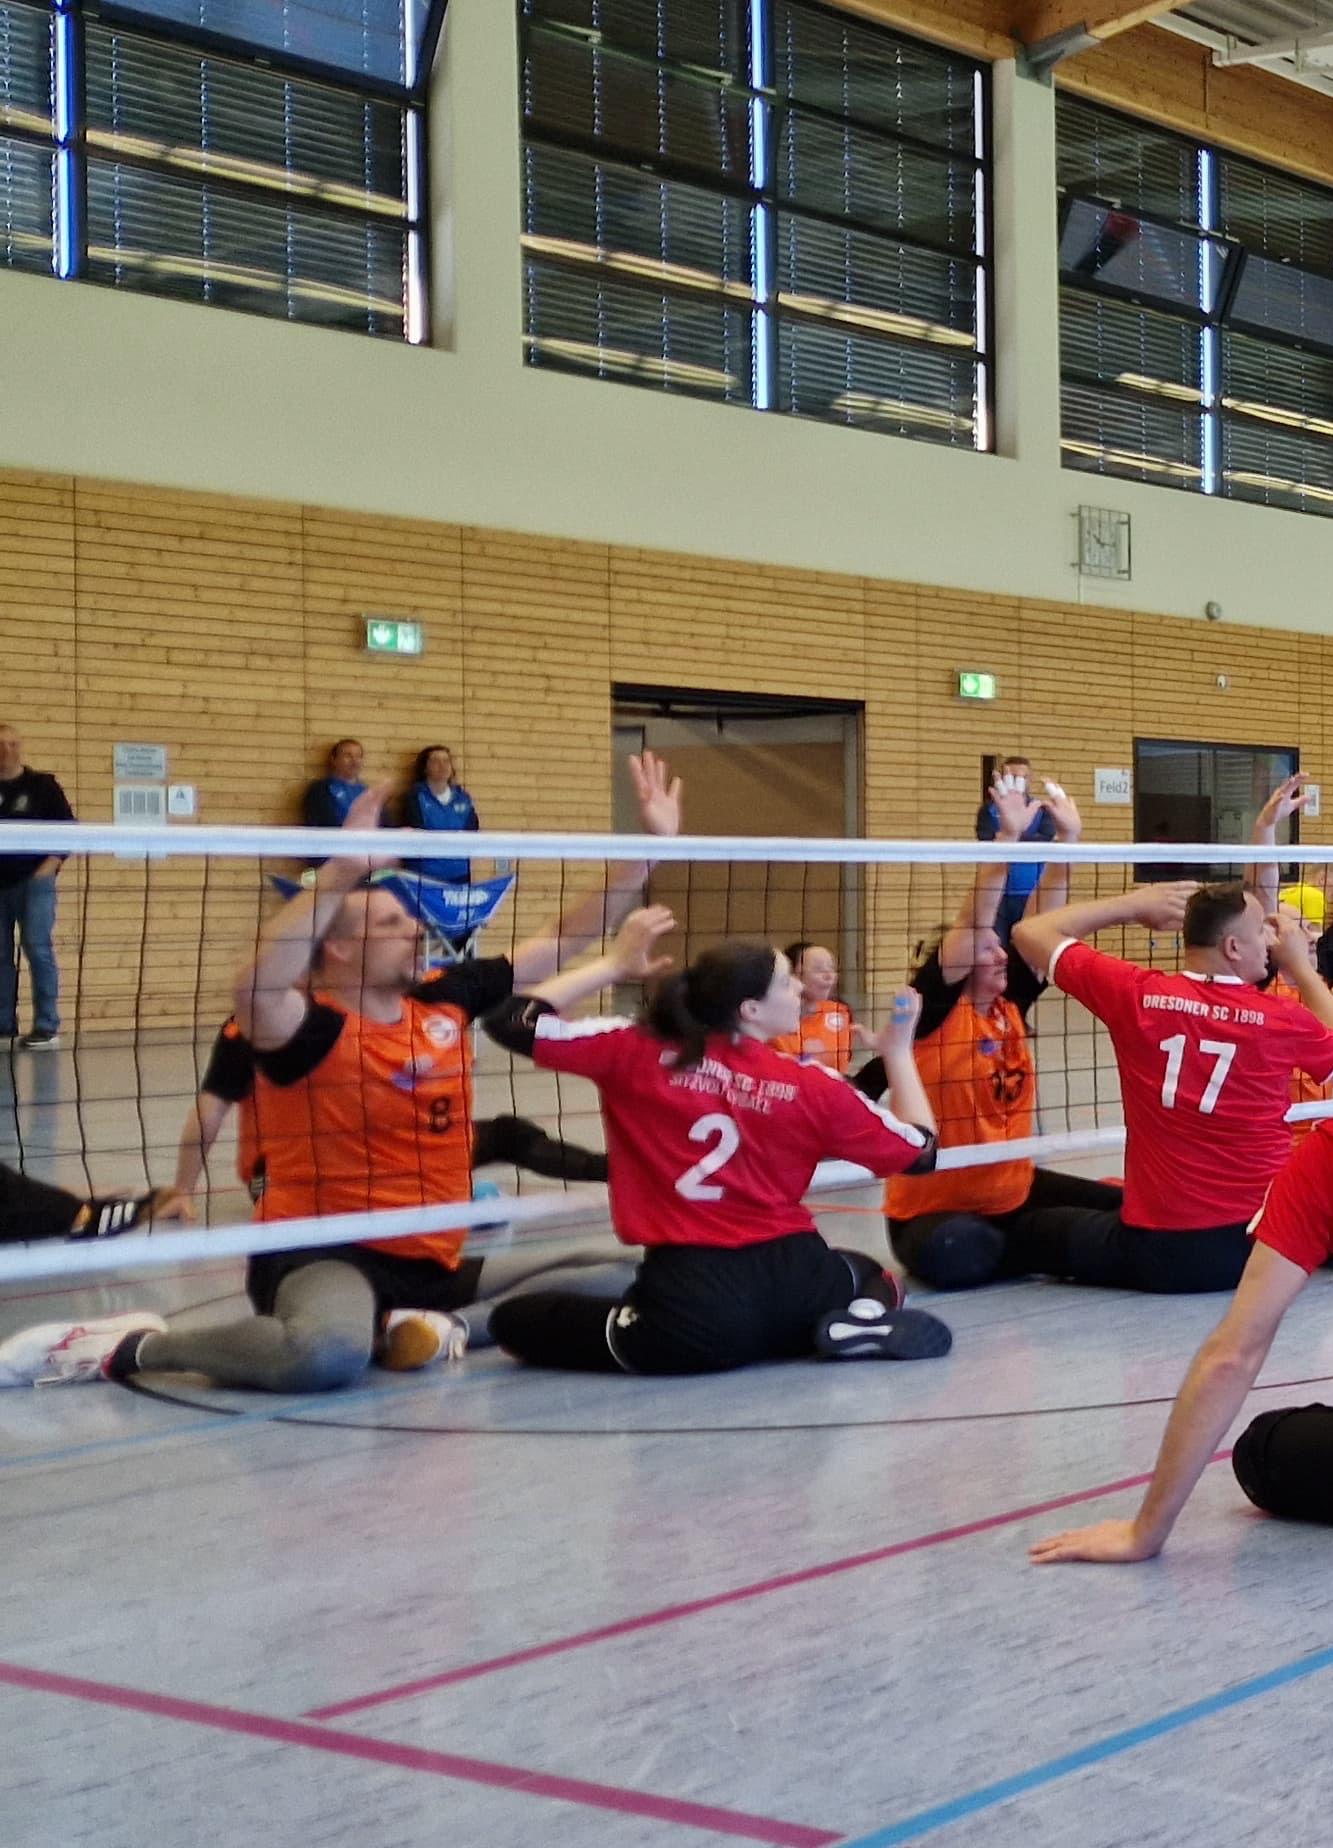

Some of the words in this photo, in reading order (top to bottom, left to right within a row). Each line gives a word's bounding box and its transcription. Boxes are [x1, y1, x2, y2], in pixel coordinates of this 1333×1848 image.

[1143, 995, 1210, 1017] DRESDNER
[1212, 1006, 1230, 1020] SC
[1233, 1008, 1265, 1025] 1898
[1160, 1034, 1237, 1114] 17
[428, 1097, 451, 1134] 8
[674, 1113, 740, 1200] 2
